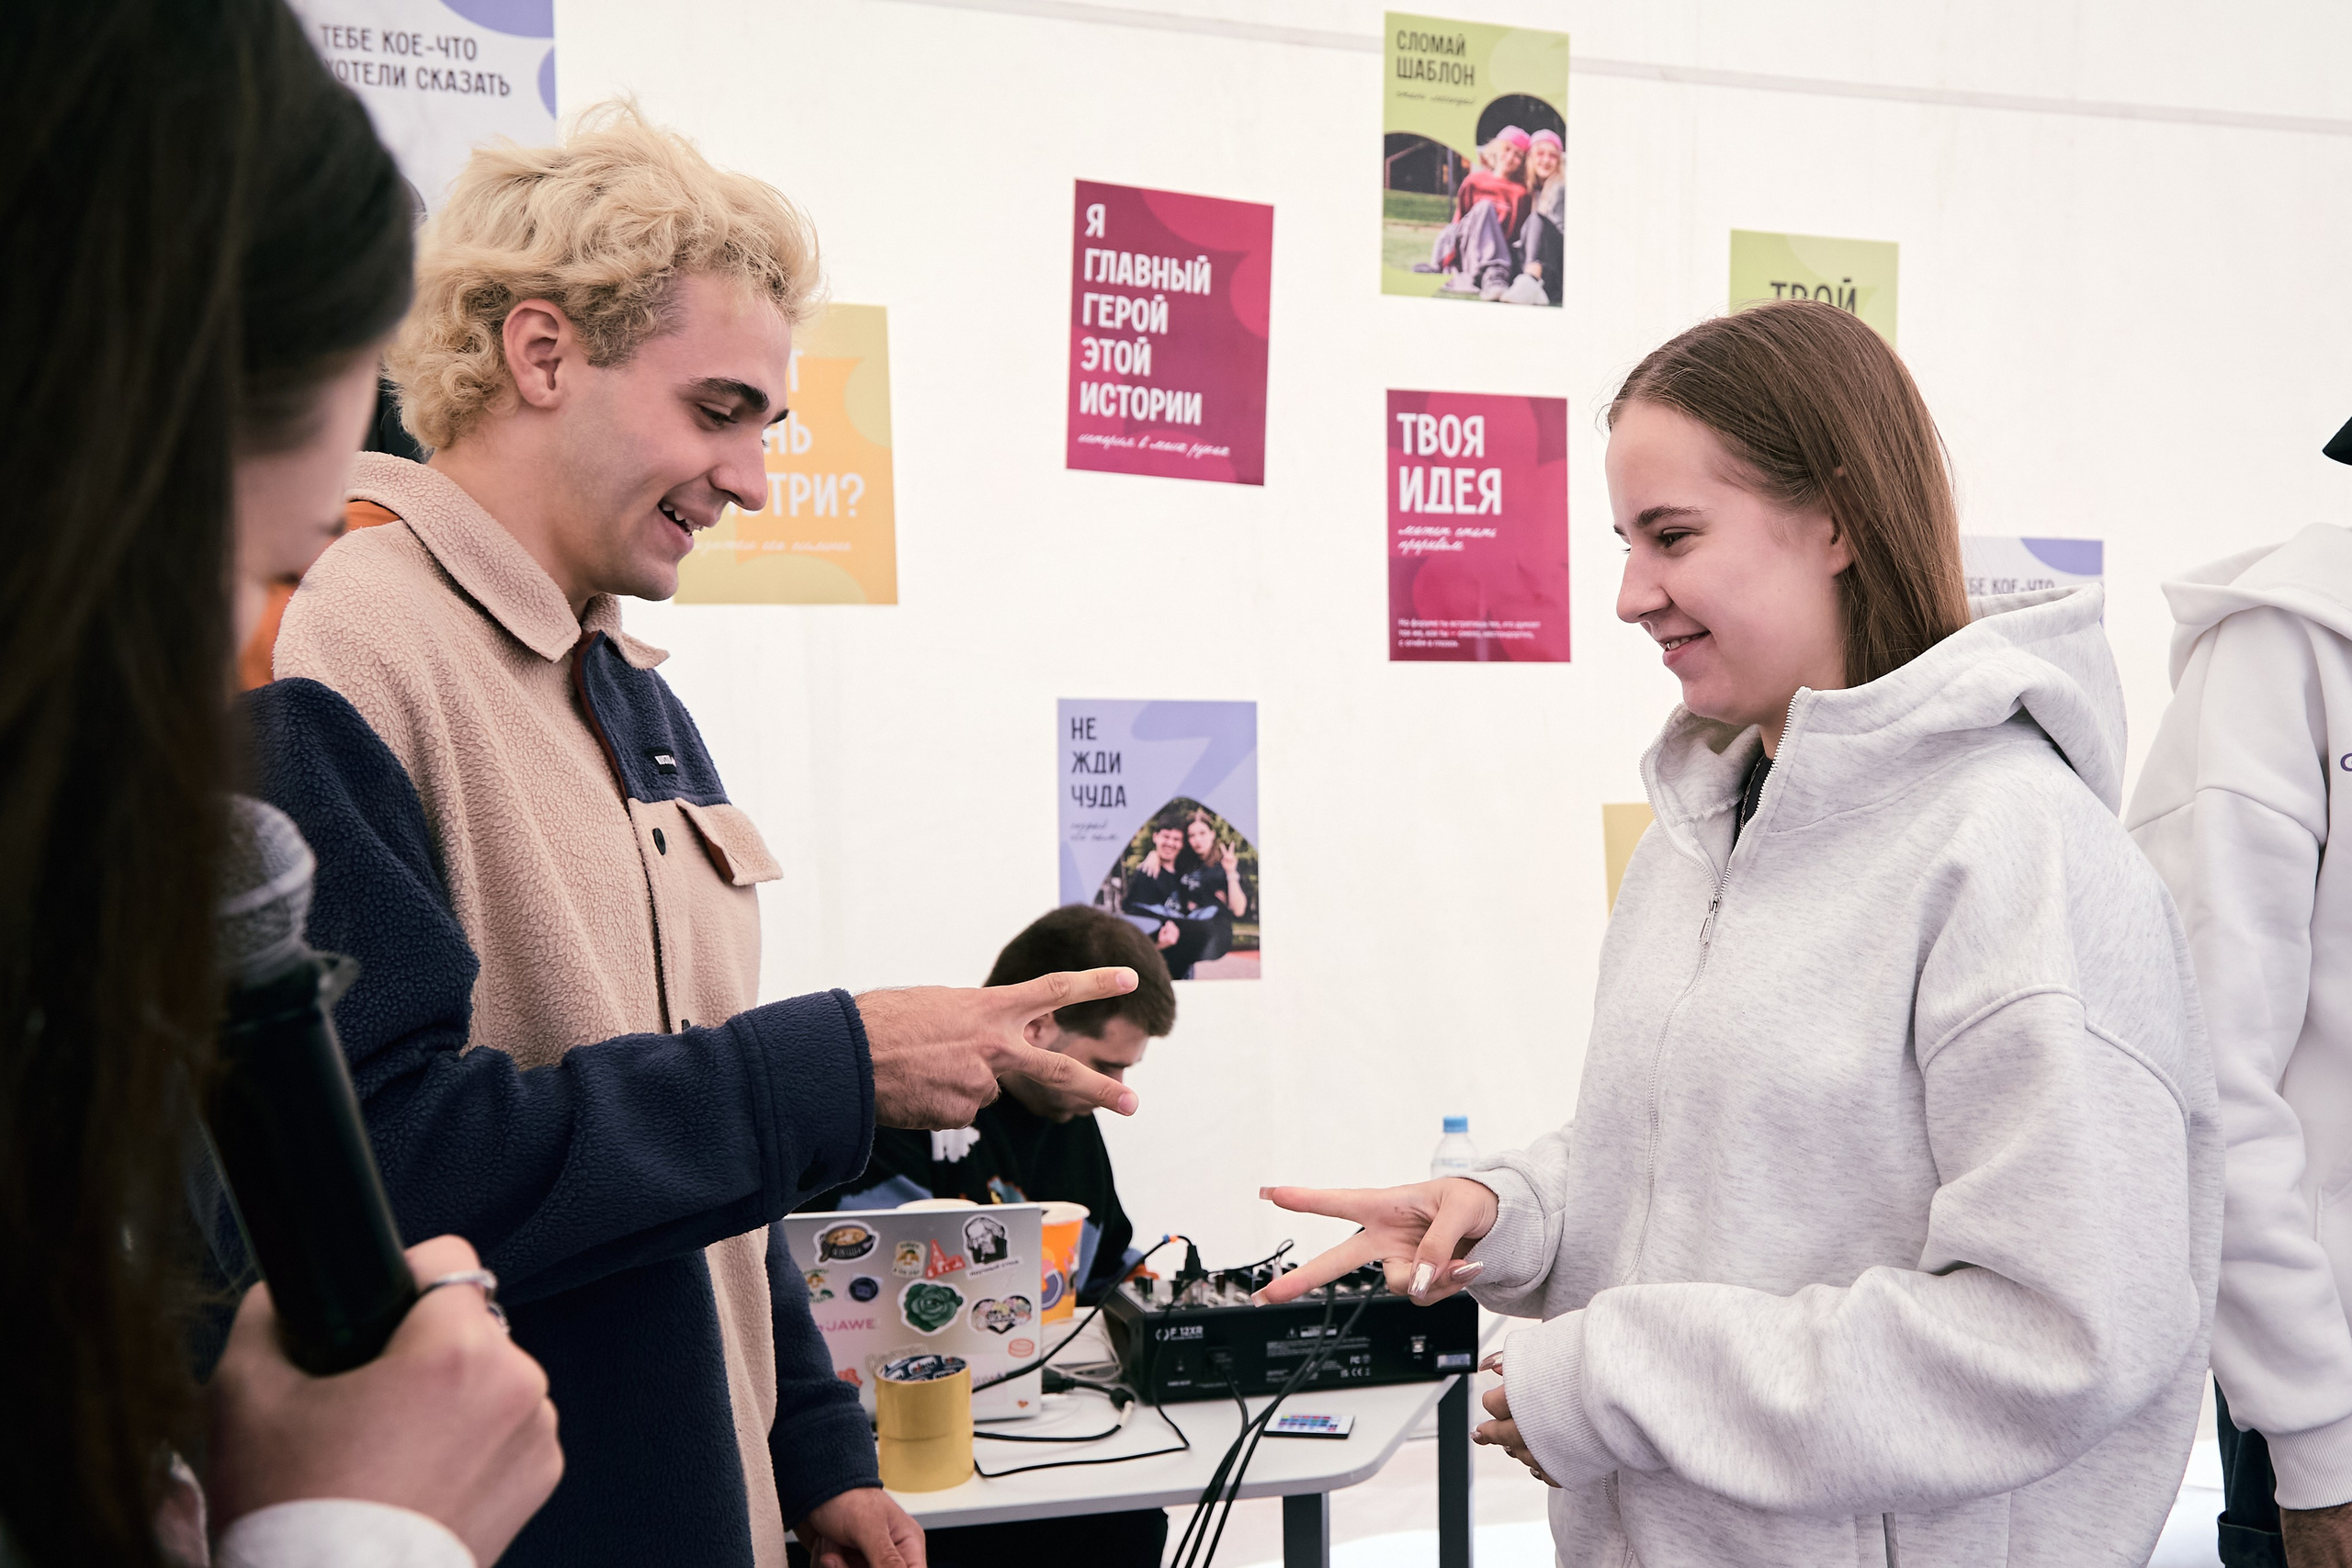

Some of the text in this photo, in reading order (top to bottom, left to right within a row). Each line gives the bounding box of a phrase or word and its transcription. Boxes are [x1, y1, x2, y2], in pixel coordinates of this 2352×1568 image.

[321, 25, 478, 62] ТЕБЕ КОЕ-ЧТО
[1396, 29, 1466, 57] СЛОМАЙ
[415, 66, 512, 96] СКАЗАТЬ
[1396, 56, 1476, 86] ШАБЛОН
[1085, 203, 1106, 239] Я
[1083, 247, 1212, 296] ГЛАВНЫЙ
[1082, 292, 1169, 335] ГЕРОЙ
[1080, 336, 1151, 378] ЭТОЙ
[1079, 381, 1203, 426] ИСТОРИИ
[1396, 412, 1485, 458] ТВОЯ
[1398, 466, 1502, 515] ИДЕЯ
[1070, 716, 1098, 740] НЕ
[1071, 750, 1122, 774] ЖДИ
[1070, 784, 1127, 808] ЧУДА
